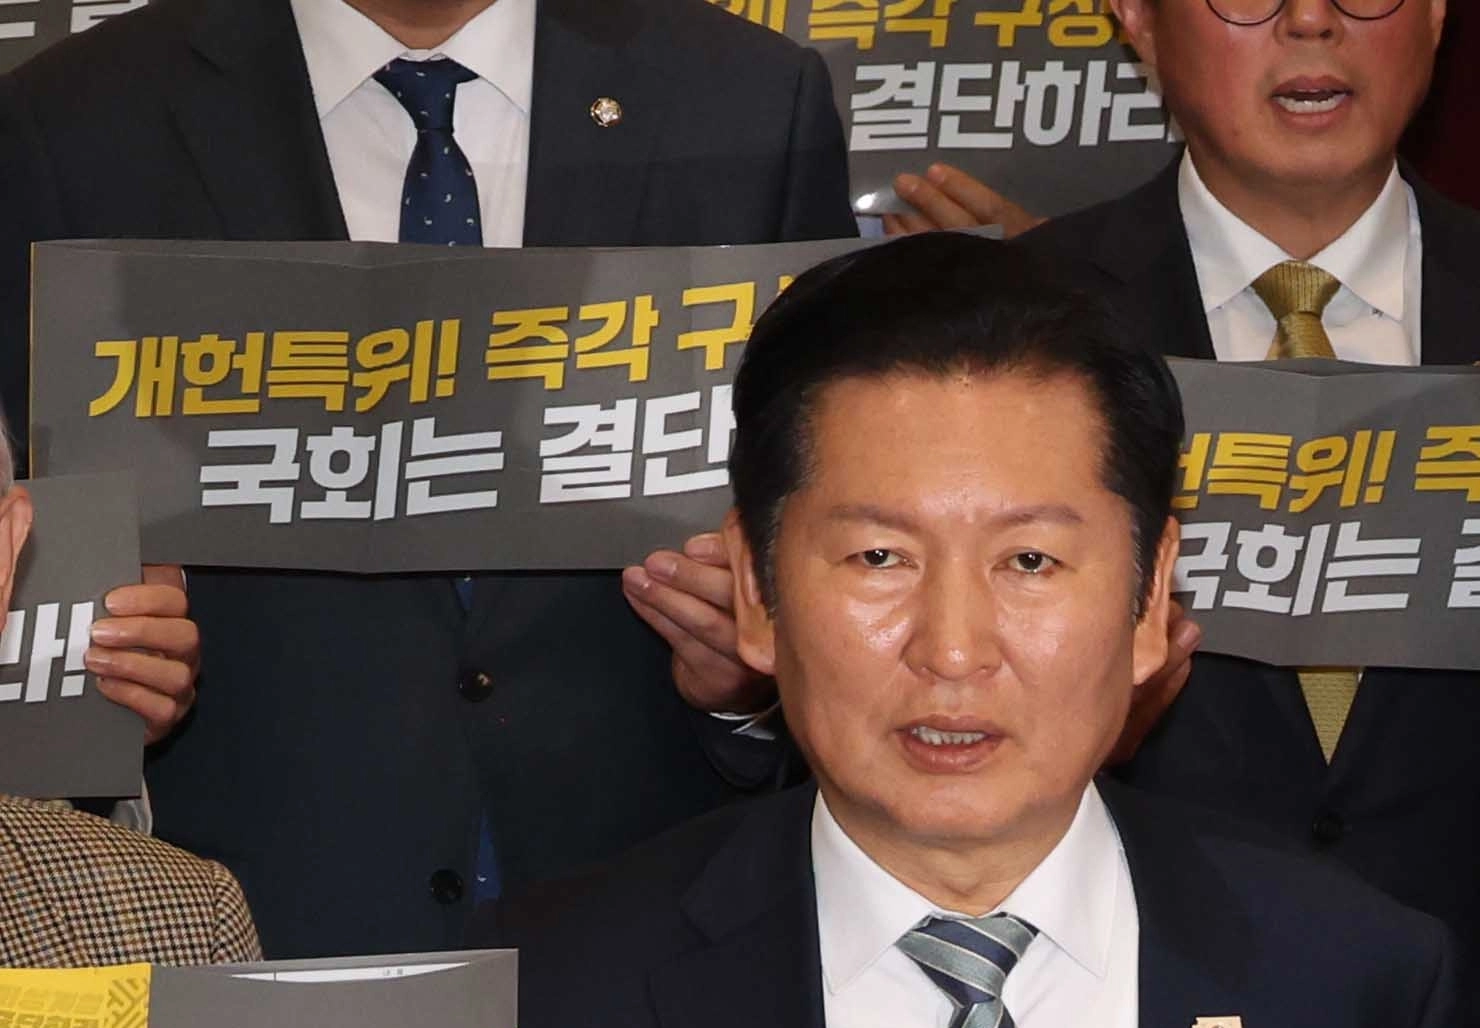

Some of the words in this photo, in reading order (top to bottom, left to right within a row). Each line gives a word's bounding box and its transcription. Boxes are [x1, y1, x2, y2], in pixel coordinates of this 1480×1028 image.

[808, 0, 954, 50] 즉각
[974, 0, 1130, 47] 구성
[89, 320, 460, 417] 개헌특위!
[486, 296, 660, 389] 즉각
[677, 275, 796, 371] 구
[201, 418, 504, 523] 국회는
[1171, 517, 1421, 617] 국회는
